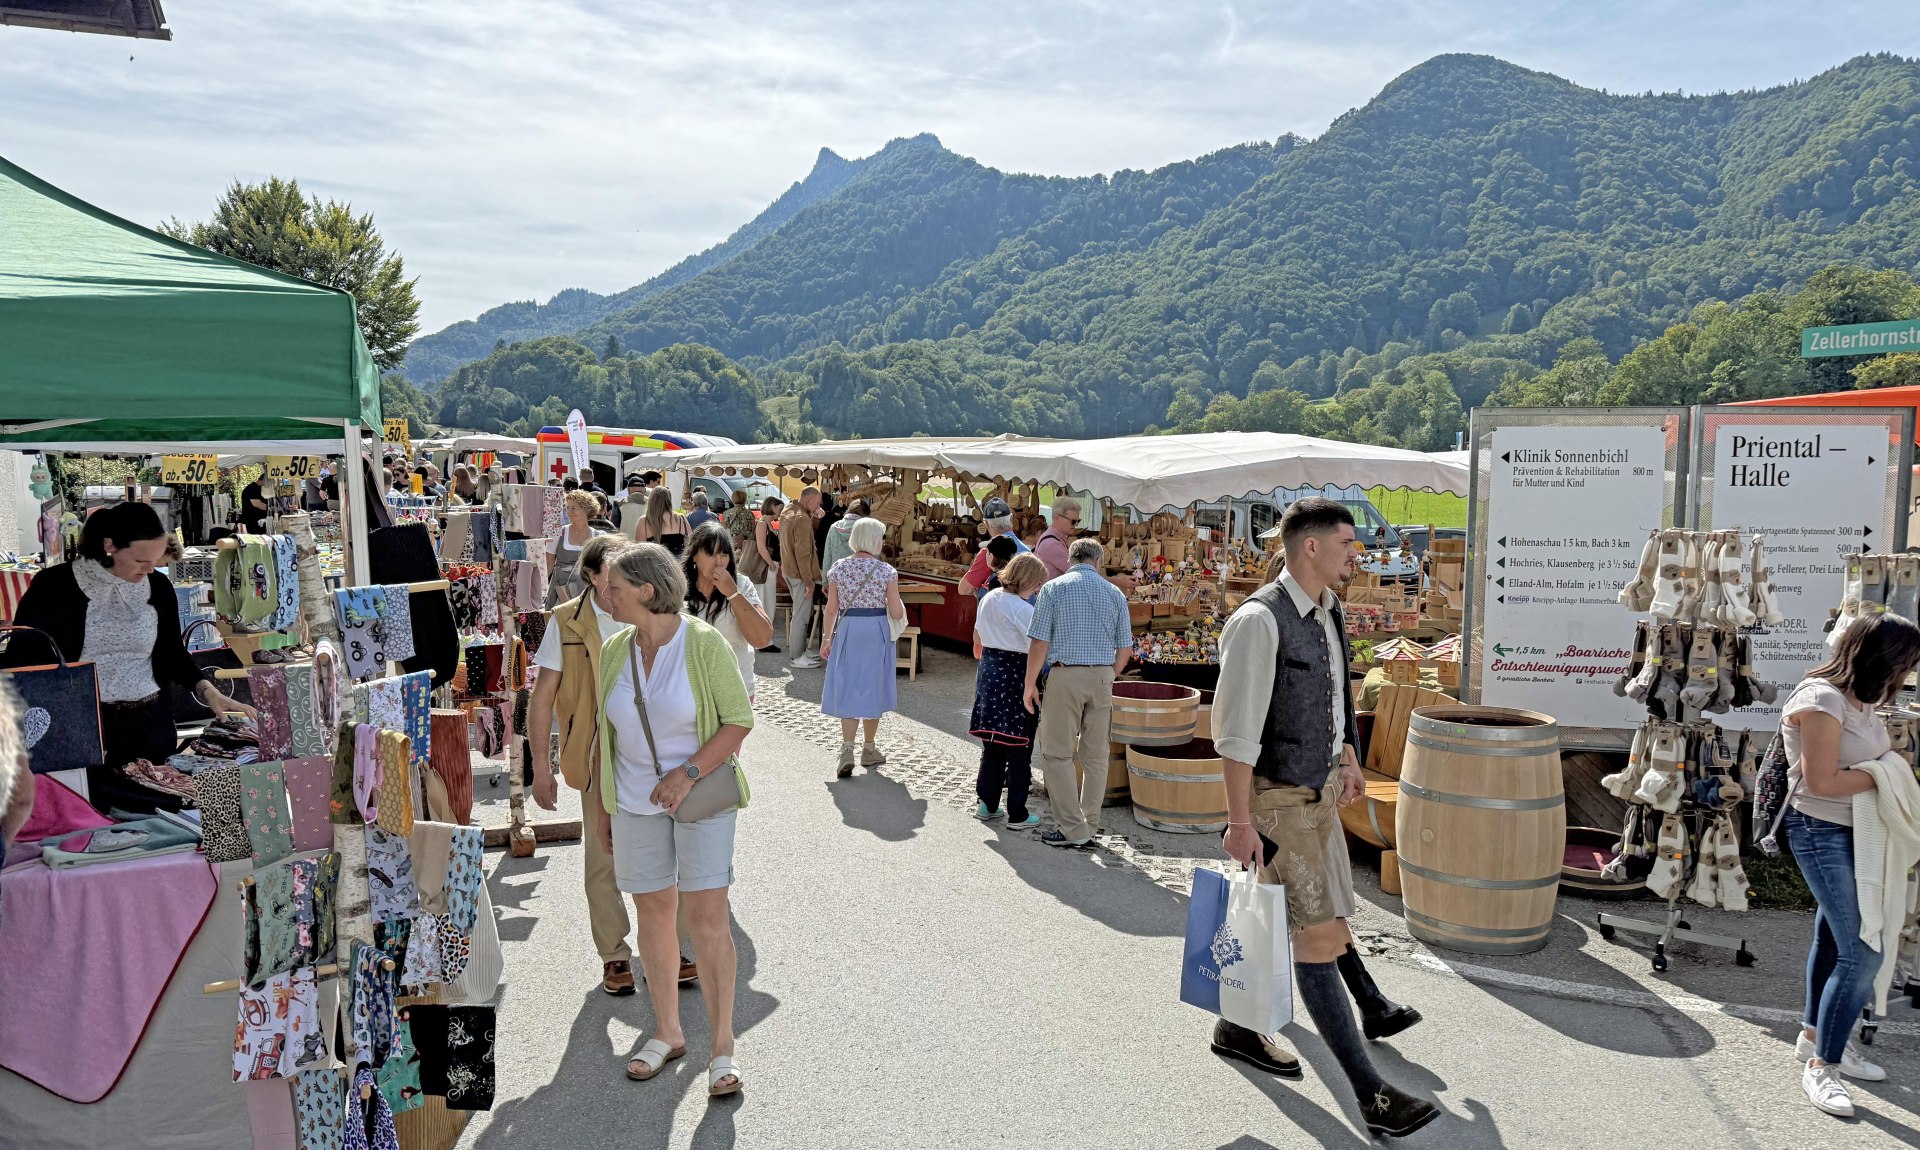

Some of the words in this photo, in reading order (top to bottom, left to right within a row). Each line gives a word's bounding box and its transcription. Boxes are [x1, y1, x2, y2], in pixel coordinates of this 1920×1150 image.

[1731, 434, 1822, 458] Priental
[1514, 450, 1551, 463] Klinik
[1554, 449, 1629, 463] Sonnenbichl
[1512, 466, 1554, 476] Prävention
[1556, 468, 1563, 476] &
[1565, 466, 1620, 476] Rehabilitation
[1632, 467, 1645, 476] 800
[1729, 463, 1790, 487] Halle
[1512, 478, 1524, 488] für
[1524, 478, 1549, 488] Mutter
[1550, 478, 1565, 488] und
[1566, 478, 1585, 488] Kind
[1748, 526, 1799, 536] Kindertagesstätte
[1800, 527, 1836, 536] Spatzennest
[1837, 526, 1853, 536] 300
[1510, 538, 1561, 547] Hohenaschau
[1575, 538, 1589, 548] km,
[1591, 538, 1609, 548] Bach
[1611, 539, 1616, 548] 3
[1618, 538, 1630, 548] km
[1836, 544, 1852, 553] 500
[1510, 558, 1545, 568] Hochries,
[1547, 559, 1594, 571] Klausenberg
[1598, 560, 1606, 570] je
[1607, 560, 1612, 568] 3
[1622, 560, 1637, 569] Std.
[1777, 564, 1807, 575] Fellerer,
[1809, 565, 1826, 574] Drei
[1828, 565, 1845, 574] Lind
[1509, 579, 1554, 589] Elland-Alm,
[1556, 580, 1584, 589] Hofalm
[1588, 581, 1596, 591] je
[1598, 581, 1601, 589] 1
[1532, 597, 1577, 605] Kneipp-Anlage
[1515, 646, 1529, 655] 1,5
[1530, 647, 1546, 655] km
[1754, 640, 1781, 649] Sanitär,
[1783, 640, 1823, 651] Spenglerei
[1760, 652, 1816, 661] Schützenstraße
[1817, 653, 1822, 661] 4
[1733, 706, 1782, 716] Chiemgau
